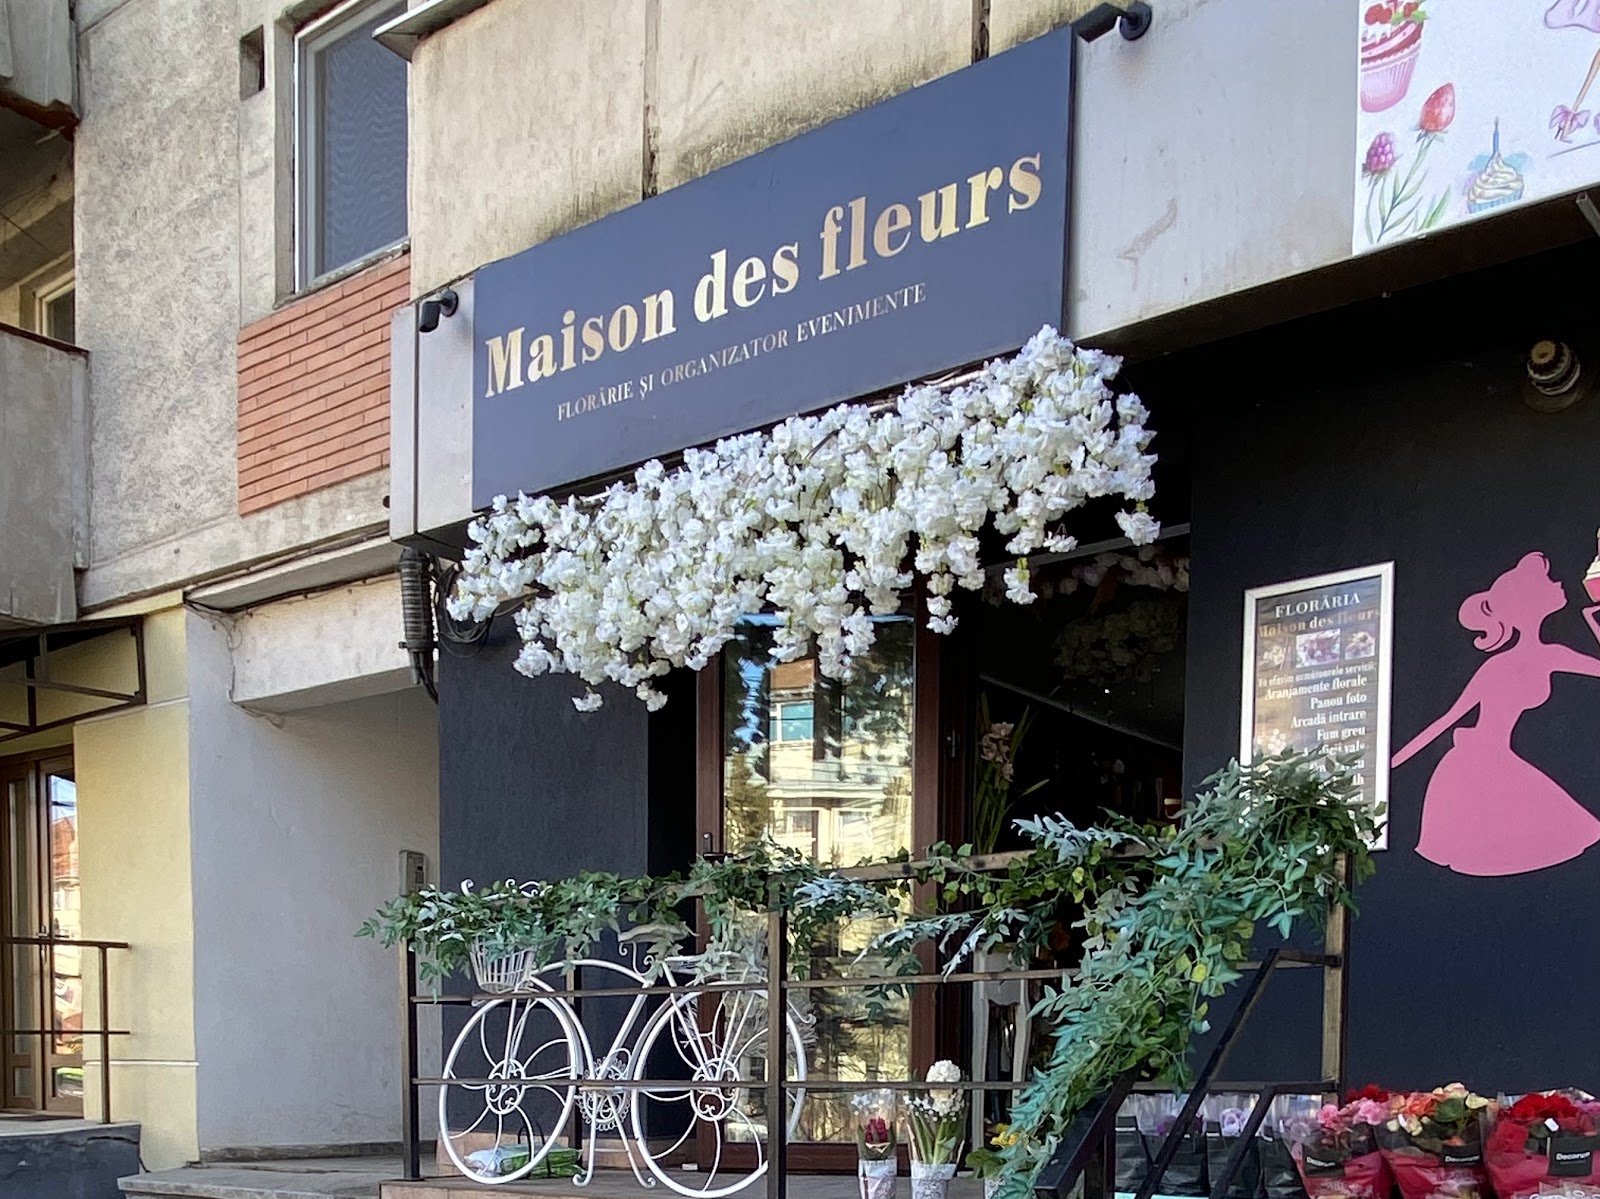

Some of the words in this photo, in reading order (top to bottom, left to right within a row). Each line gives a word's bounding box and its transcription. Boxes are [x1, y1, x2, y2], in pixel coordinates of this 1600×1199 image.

[485, 289, 677, 398] Maison
[693, 241, 799, 323] des
[818, 152, 1042, 281] fleurs
[557, 381, 634, 421] FLORĂRIE
[661, 330, 788, 386] ORGANIZATOR
[797, 282, 927, 343] EVENIMENTE
[1275, 592, 1360, 619] FLORĂRIA
[1309, 616, 1334, 630] des
[1264, 679, 1330, 701] Aranjamente
[1332, 674, 1368, 690] florale
[1310, 694, 1344, 710] Panou
[1346, 691, 1368, 705] foto
[1328, 709, 1367, 723] intrare
[1317, 728, 1339, 742] Fum
[1341, 726, 1366, 740] greu
